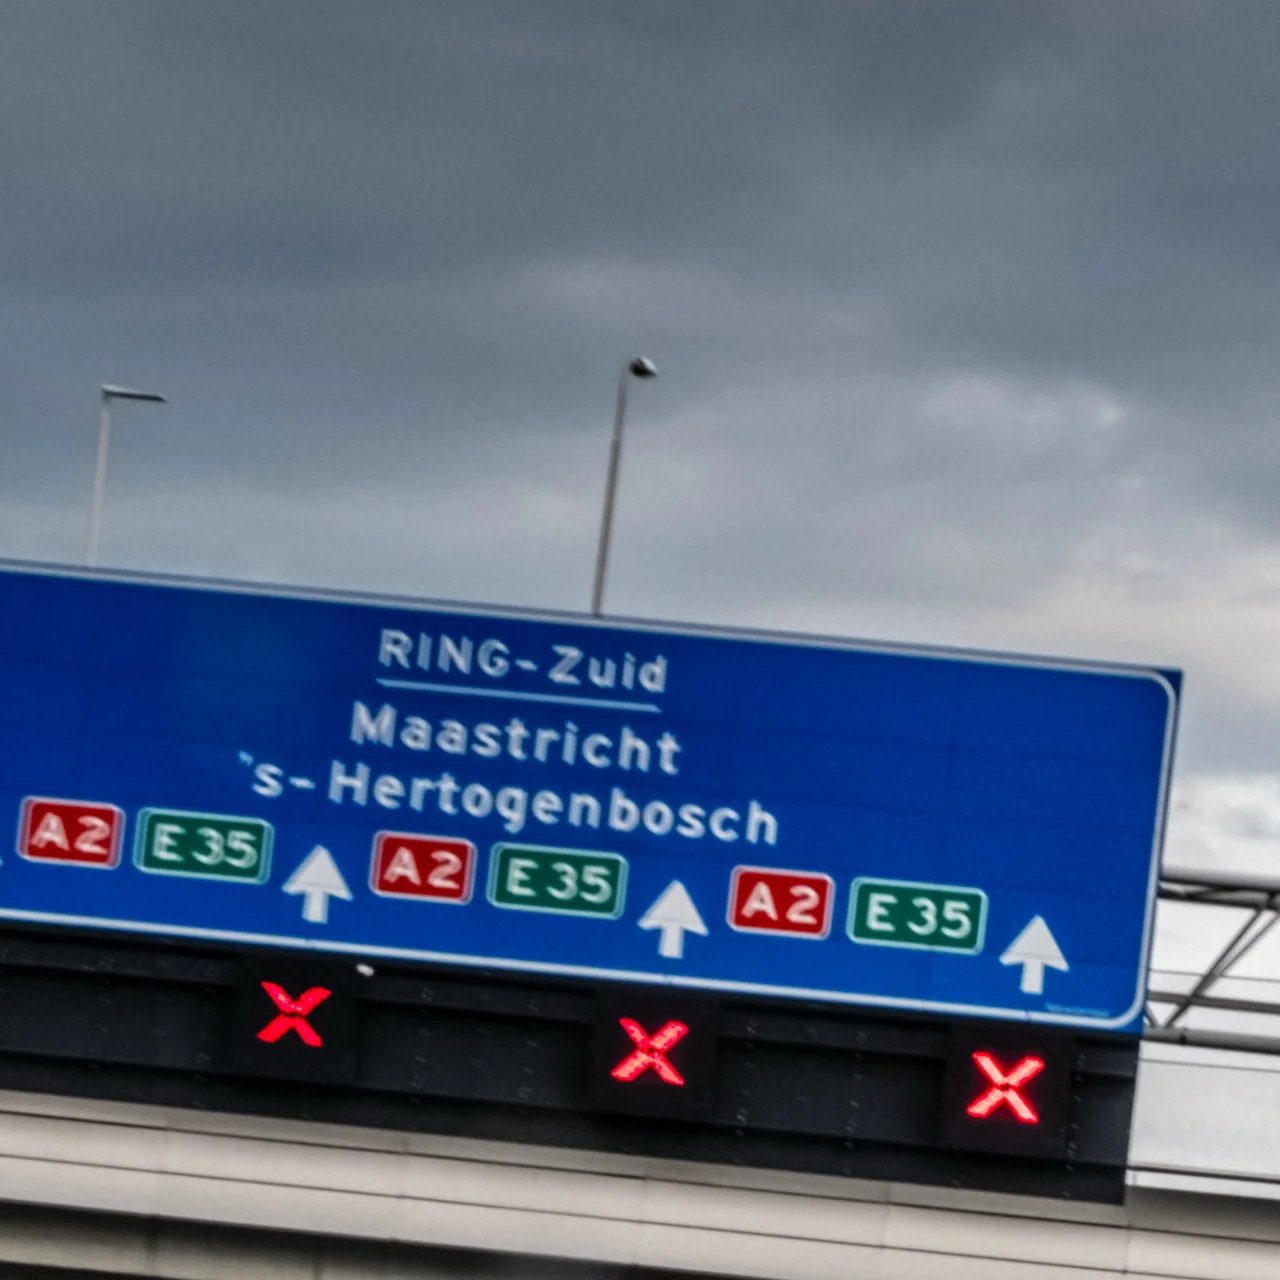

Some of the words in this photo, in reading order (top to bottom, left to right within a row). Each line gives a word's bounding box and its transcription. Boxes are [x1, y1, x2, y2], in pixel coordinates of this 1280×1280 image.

[378, 628, 668, 693] RING-Zuid
[350, 701, 681, 775] Maastricht
[31, 813, 111, 854] A2
[383, 847, 462, 890] A2
[741, 882, 820, 924] A2
